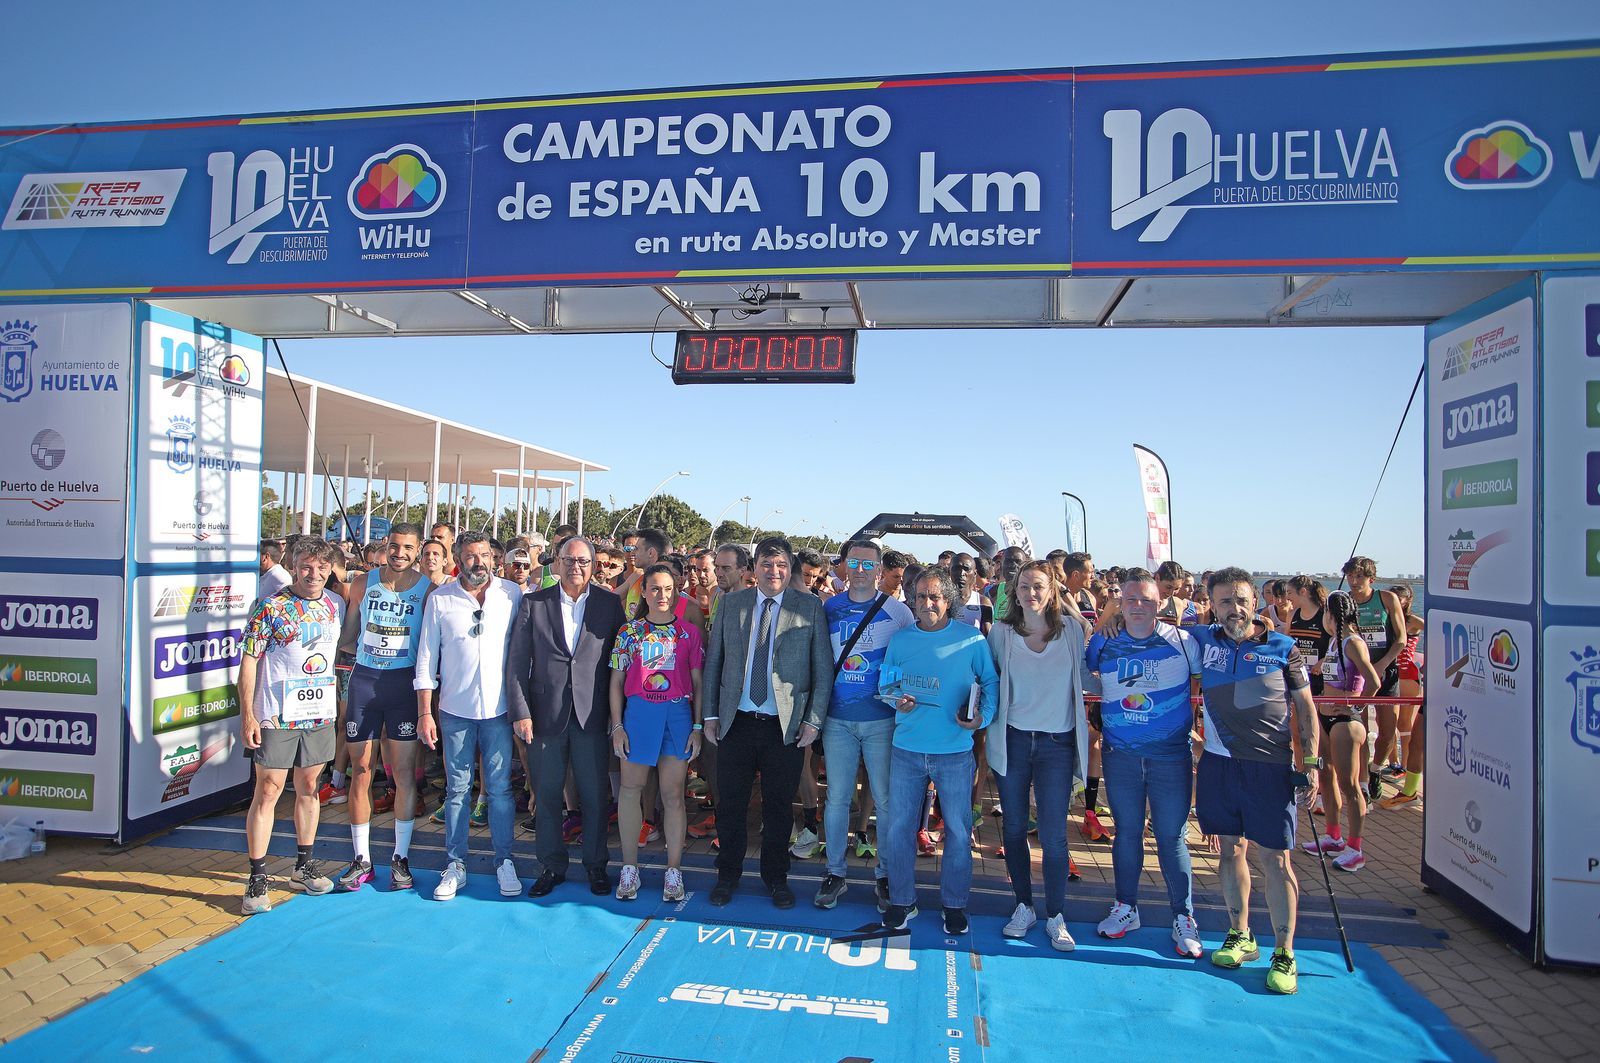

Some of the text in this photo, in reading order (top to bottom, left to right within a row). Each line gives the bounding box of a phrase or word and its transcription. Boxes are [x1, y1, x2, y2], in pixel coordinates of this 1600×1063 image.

[502, 104, 892, 163] CAMPEONATO
[290, 146, 334, 173] HU
[1214, 127, 1399, 183] HUELVA
[1103, 107, 1212, 242] 10
[84, 182, 140, 194] RFEA
[289, 174, 332, 201] EL
[498, 152, 1041, 222] de ESPAÑA 10 km
[1213, 182, 1399, 203] PUERTA DEL DESCUBRIMIENTO
[76, 195, 164, 207] ATLETISMO
[207, 149, 285, 264] 10
[71, 207, 166, 218] RUTA RUNNING
[289, 202, 330, 229] VA
[283, 236, 328, 249] PUERTA DEL
[358, 224, 431, 250] WiHu
[634, 222, 1041, 254] en ruta Absoluto y Master
[260, 249, 328, 263] DESCUBRIMIENTO
[361, 252, 391, 260] INTERNET
[397, 250, 429, 259] TELEFONÍA
[1475, 326, 1505, 347] RFEA
[1472, 334, 1519, 360] ATLETISMO
[42, 361, 120, 372] Ayuntamiento de
[161, 336, 196, 397] 10
[1470, 346, 1521, 370] RUTA RUNNING
[41, 374, 119, 391] HUELVA
[223, 385, 246, 399] WiHu
[1447, 394, 1514, 441] Joma
[199, 457, 241, 472] HUELVA
[0, 481, 99, 493] Puerto de Huelva
[1463, 477, 1513, 496] IBERDROLA
[36, 519, 64, 527] Portuaria
[65, 519, 72, 527] de
[173, 521, 230, 530] Puerto de Huelva
[195, 595, 244, 604] ATLETISMO
[199, 585, 231, 596] RFEA
[1, 602, 93, 631] Joma
[192, 603, 245, 613] RUTA RUNNING
[367, 599, 415, 616] nerja
[373, 615, 408, 625] ATLETISMO
[380, 637, 389, 647] 5
[159, 634, 239, 672] Joma
[1442, 621, 1469, 688] 10
[25, 670, 91, 684] IBERDROLA
[844, 673, 865, 682] WiHu
[902, 672, 940, 690] HUELVA
[1117, 657, 1144, 687] 10
[1493, 671, 1516, 690] WiHu
[297, 688, 323, 701] 690
[646, 693, 667, 701] WiHu
[184, 697, 237, 718] IBERDROLA
[1123, 712, 1149, 722] WiHu
[0, 716, 92, 745] Joma
[170, 754, 198, 767] F.A.A.
[1470, 748, 1511, 771] Ayuntamiento de
[1470, 759, 1511, 790] HUELVA
[21, 784, 88, 800] IBERDROLA
[1449, 828, 1498, 863] Puerto de Huelva
[698, 925, 832, 954] HUELVA
[616, 927, 669, 989] www.tugawear.com
[945, 951, 960, 1019] www.tugawear.com
[741, 988, 888, 1006] ACTIVE WEAR
